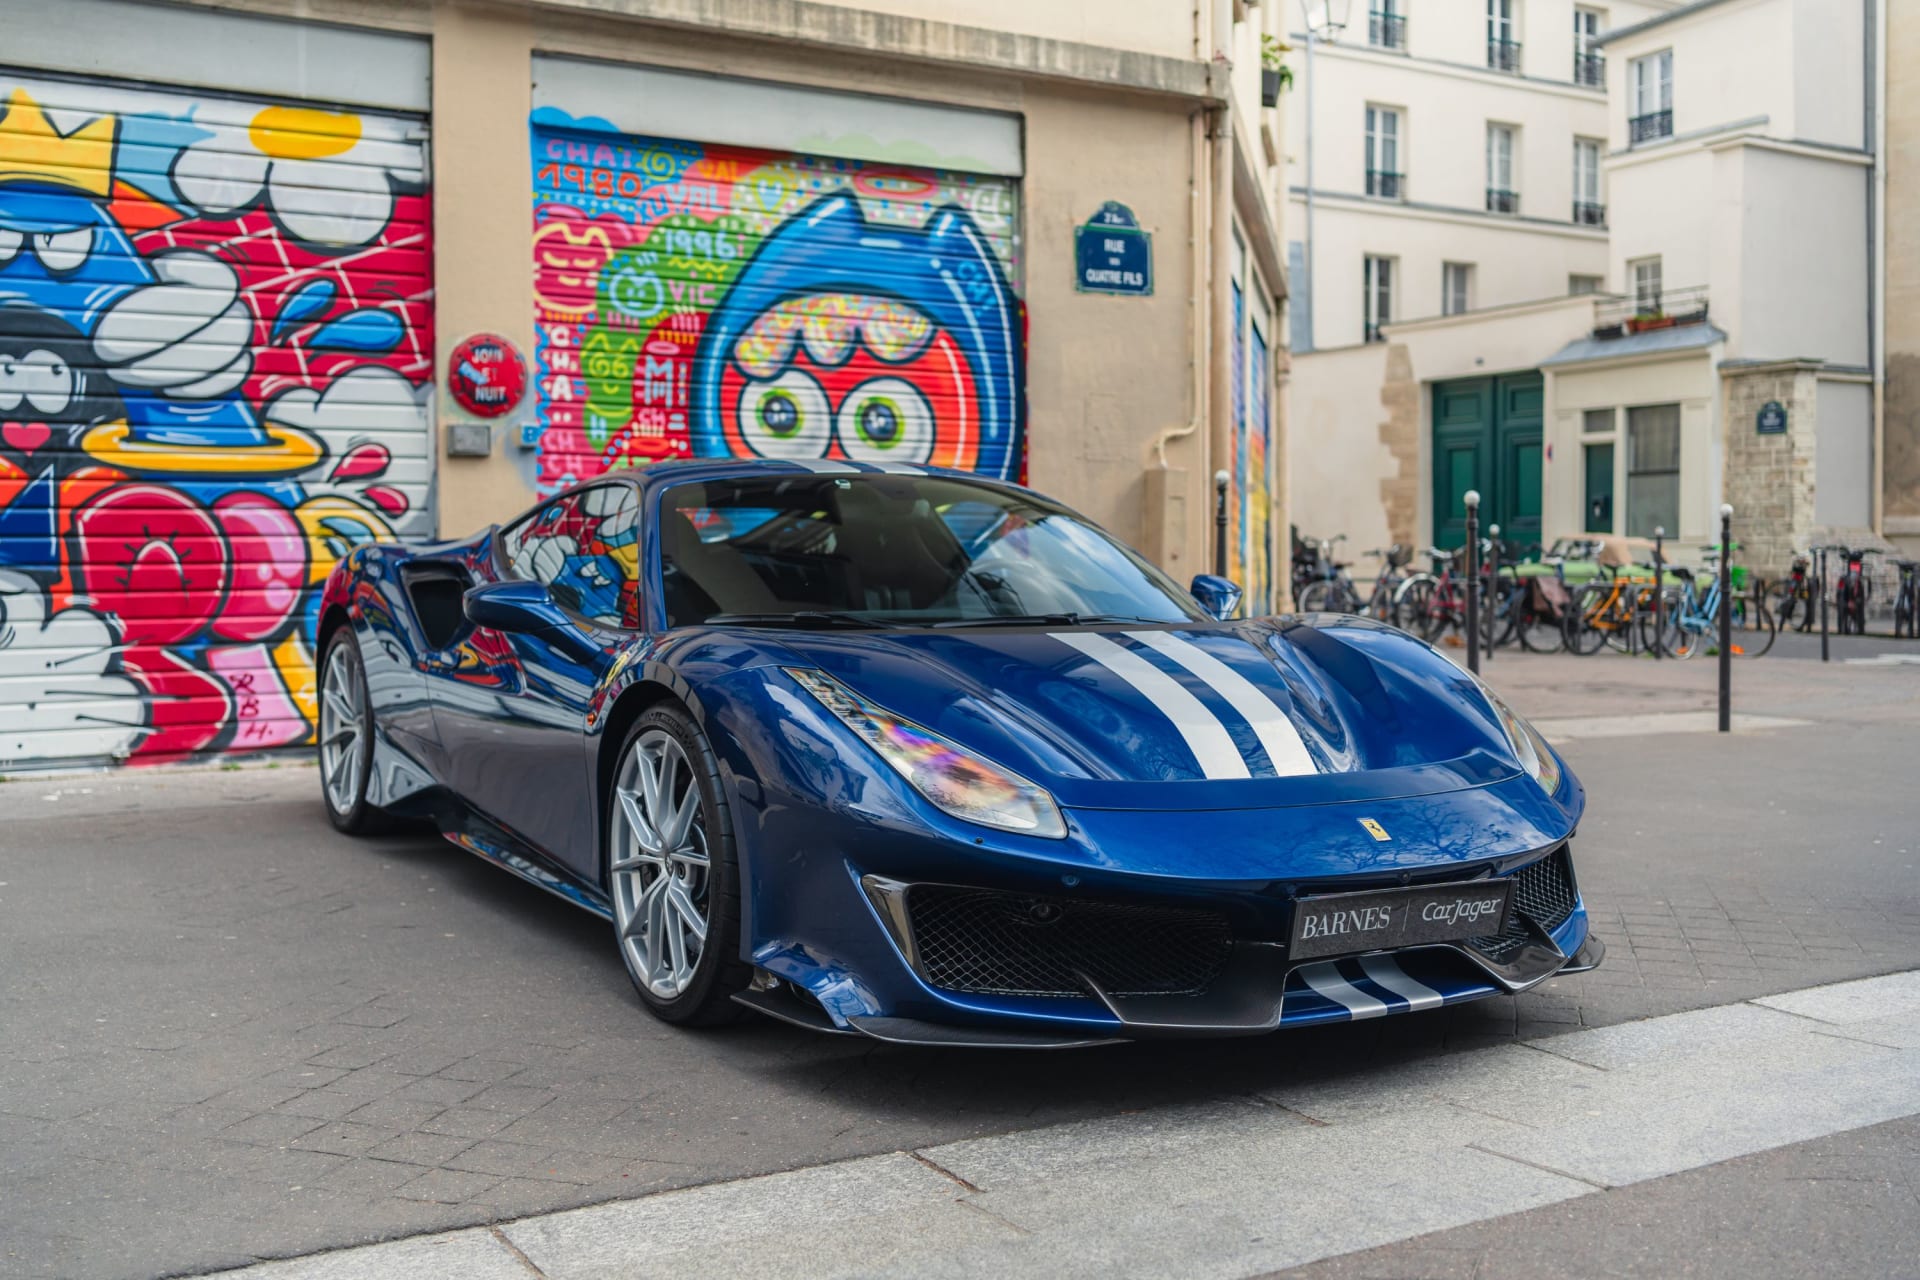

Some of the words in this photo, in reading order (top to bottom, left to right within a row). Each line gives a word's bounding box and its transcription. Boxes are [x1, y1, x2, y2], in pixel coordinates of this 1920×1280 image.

[538, 161, 643, 199] 1980
[664, 229, 737, 261] 1996
[1104, 238, 1126, 254] RUE
[1123, 271, 1144, 286] FILS
[475, 386, 506, 402] NUIT
[1301, 905, 1392, 939] BARNES
[1422, 898, 1502, 926] CarJager
